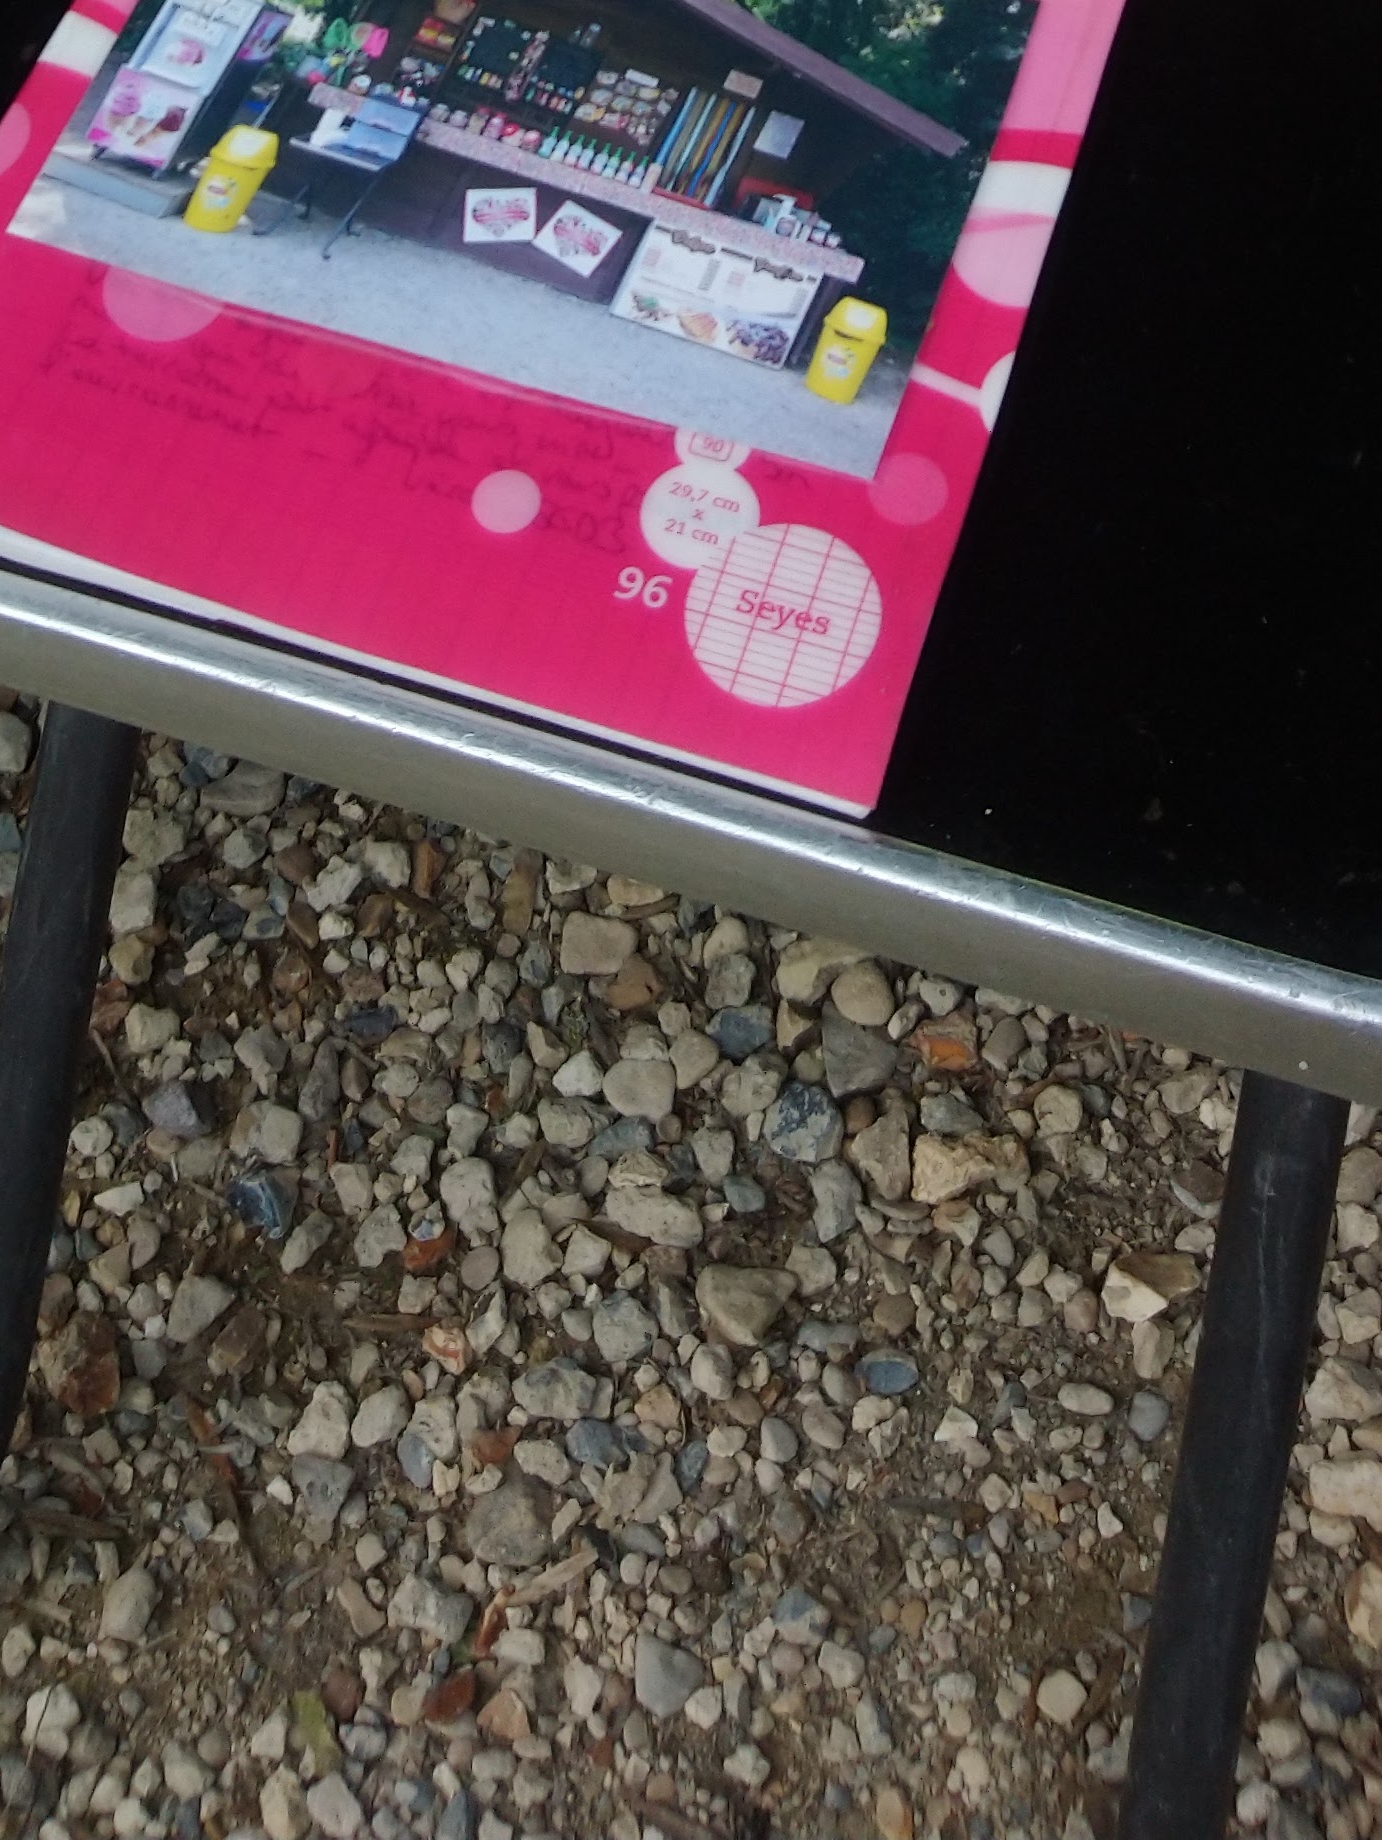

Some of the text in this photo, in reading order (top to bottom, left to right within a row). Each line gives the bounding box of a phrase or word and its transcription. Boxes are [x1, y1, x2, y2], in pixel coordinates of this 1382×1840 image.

[668, 480, 741, 514] 29,7 cm
[691, 508, 705, 521] x
[663, 519, 720, 546] 21 cm
[612, 565, 675, 609] 96
[734, 589, 832, 636] Seyes
